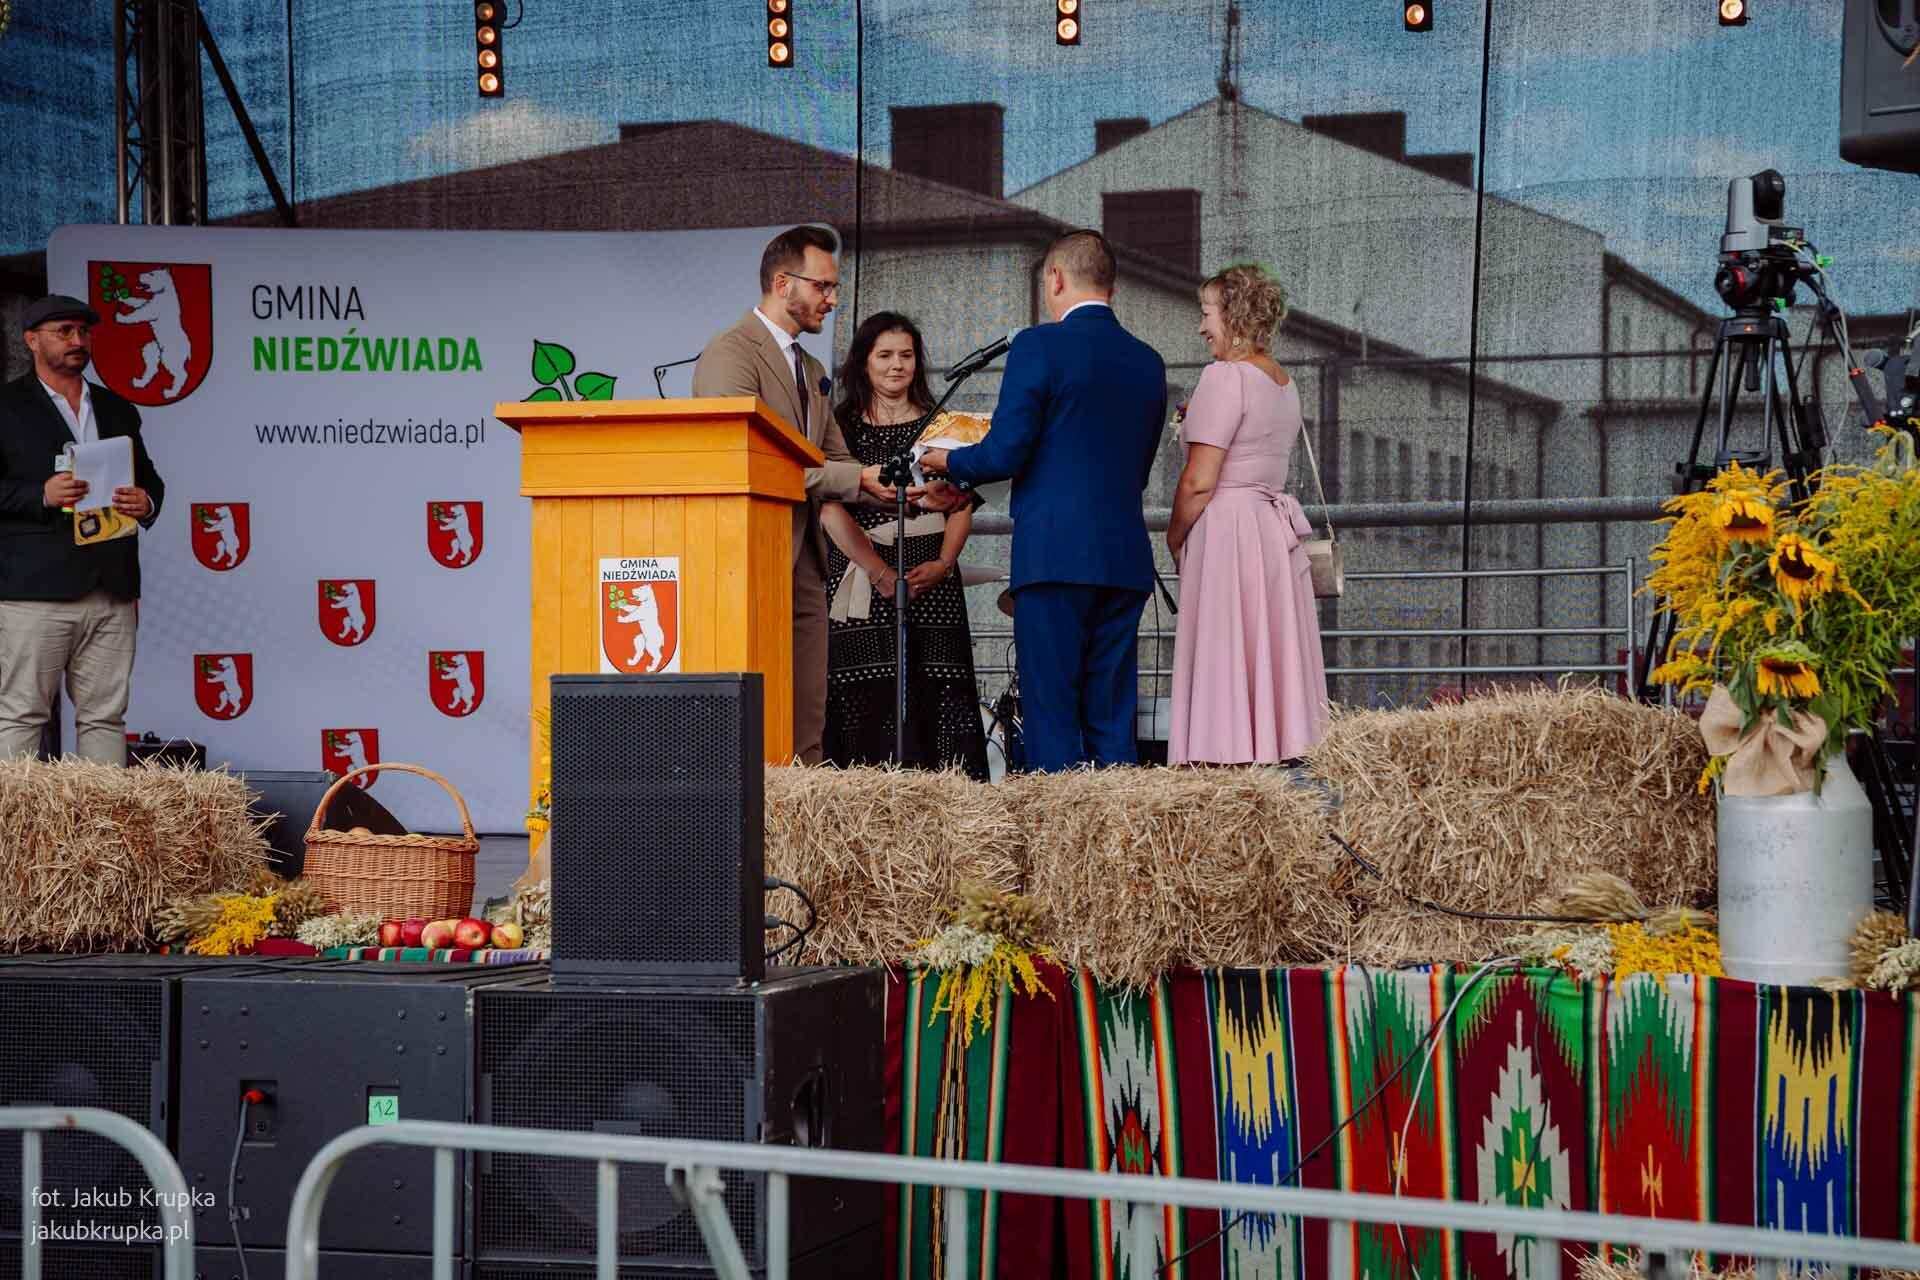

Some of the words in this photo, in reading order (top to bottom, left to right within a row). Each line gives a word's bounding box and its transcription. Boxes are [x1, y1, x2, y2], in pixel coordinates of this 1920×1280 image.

[251, 284, 365, 321] GMINA
[253, 327, 483, 372] NIEDŹWIADA
[255, 418, 486, 449] www.niedzwiada.pl
[603, 568, 676, 580] NIEDŹWIADA
[620, 559, 659, 569] GMINA
[373, 1099, 396, 1118] 12
